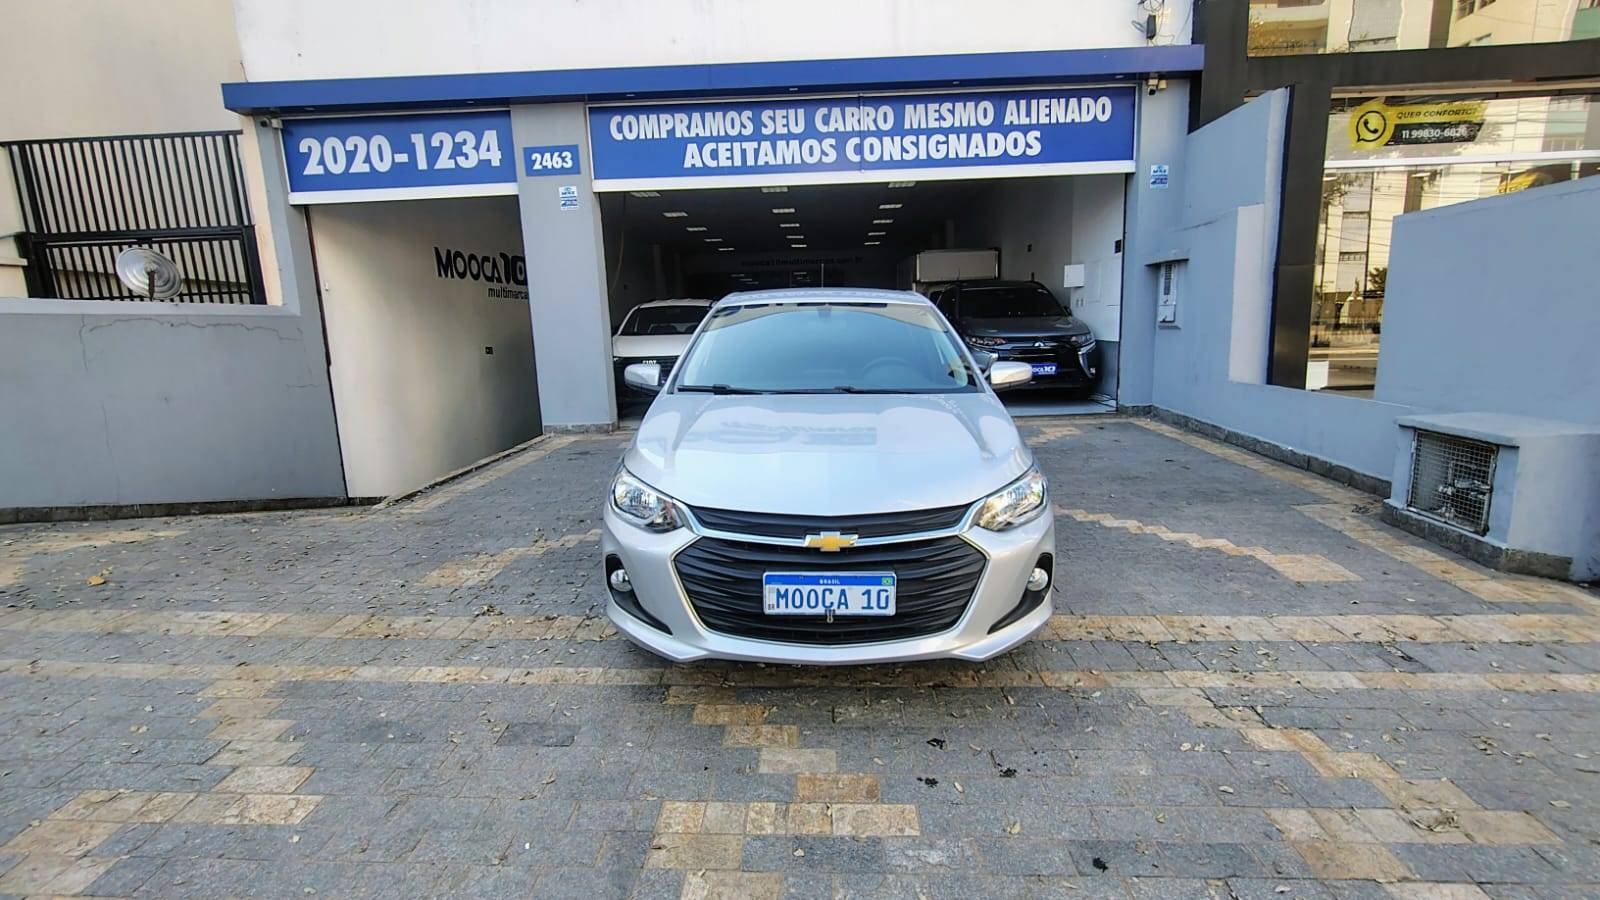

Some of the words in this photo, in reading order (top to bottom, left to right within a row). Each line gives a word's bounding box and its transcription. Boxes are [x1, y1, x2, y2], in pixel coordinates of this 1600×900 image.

[610, 111, 754, 141] COMPRAMOS
[761, 108, 806, 135] SEU
[815, 105, 894, 133] CARRO
[904, 100, 995, 129] MESMO
[1004, 96, 1112, 126] ALIENADO
[1396, 111, 1422, 120] QUER
[299, 129, 502, 175] 2020-1234
[531, 151, 573, 170] 2463
[683, 138, 837, 169] ACEITAMOS
[845, 130, 1041, 163] CONSIGNADOS
[776, 588, 849, 609] MOOCA
[861, 589, 890, 610] 10
